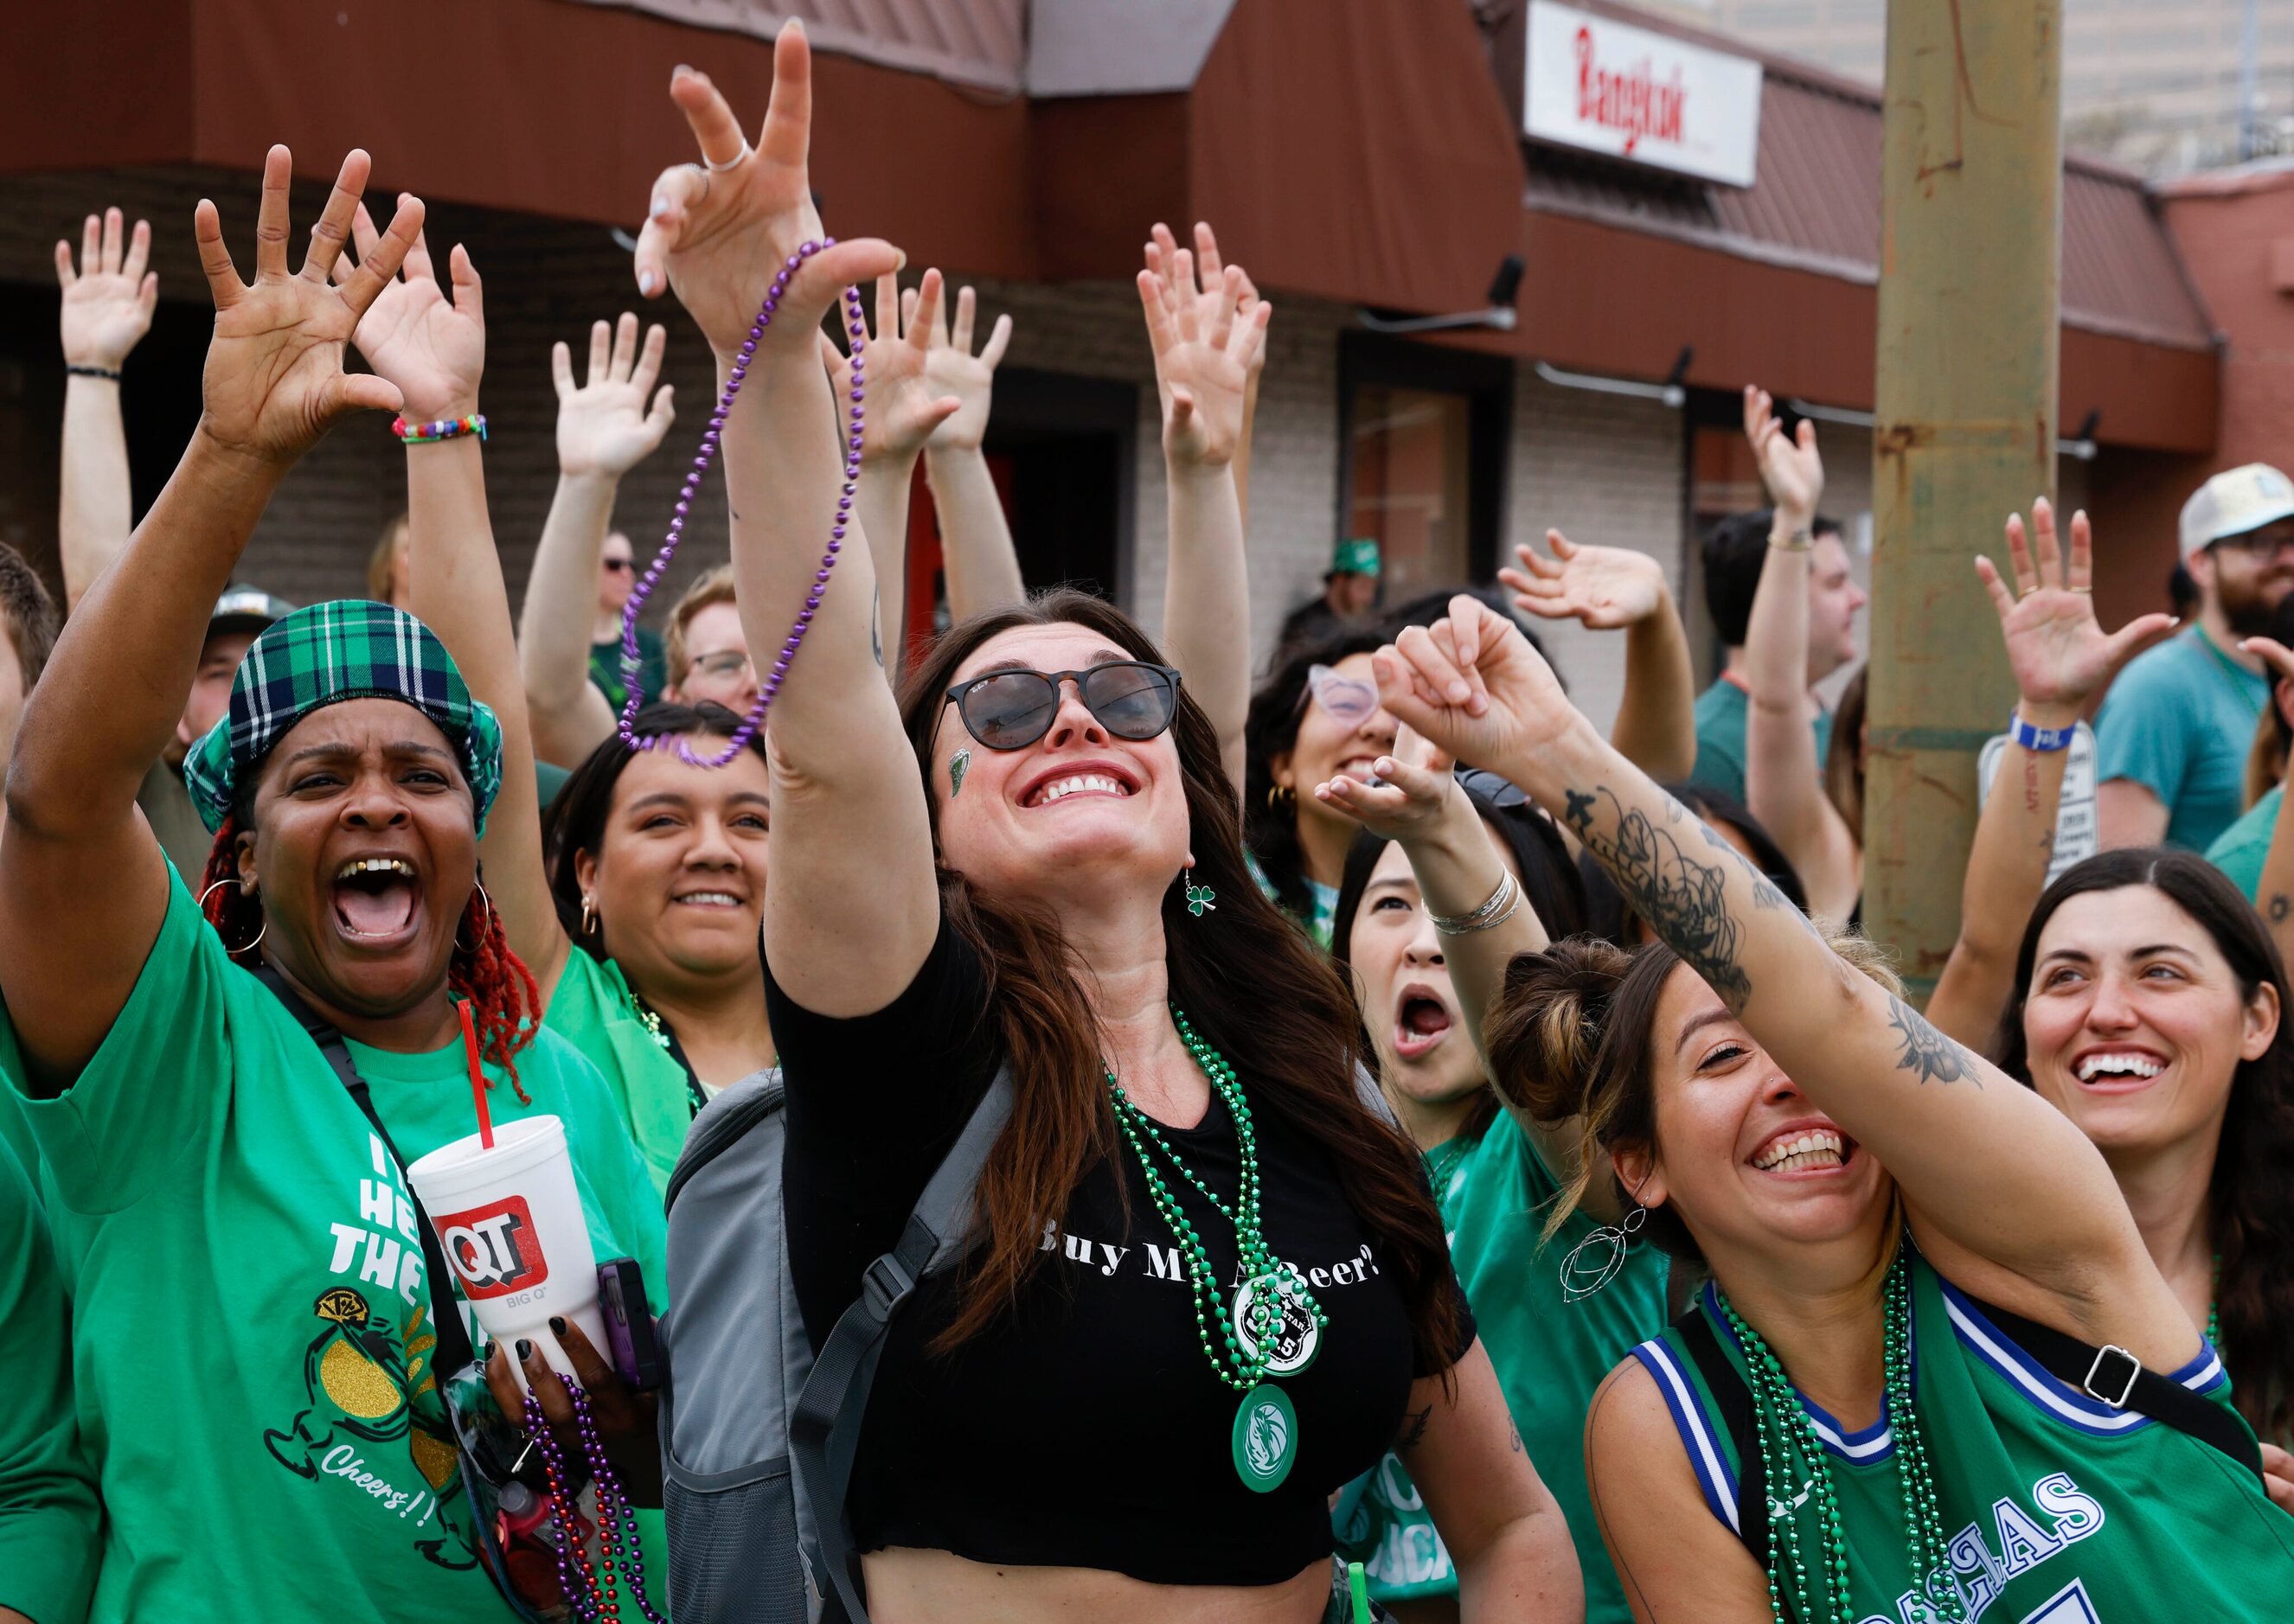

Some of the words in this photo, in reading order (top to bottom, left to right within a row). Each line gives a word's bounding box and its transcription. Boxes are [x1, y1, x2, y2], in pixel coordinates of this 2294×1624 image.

[360, 1179, 424, 1254] HE
[444, 1212, 522, 1287] QT
[506, 1294, 531, 1308] BIG
[1282, 1308, 1305, 1333] STAR
[321, 1444, 436, 1528] Cheers!!
[1855, 1471, 2105, 1624] LLAS
